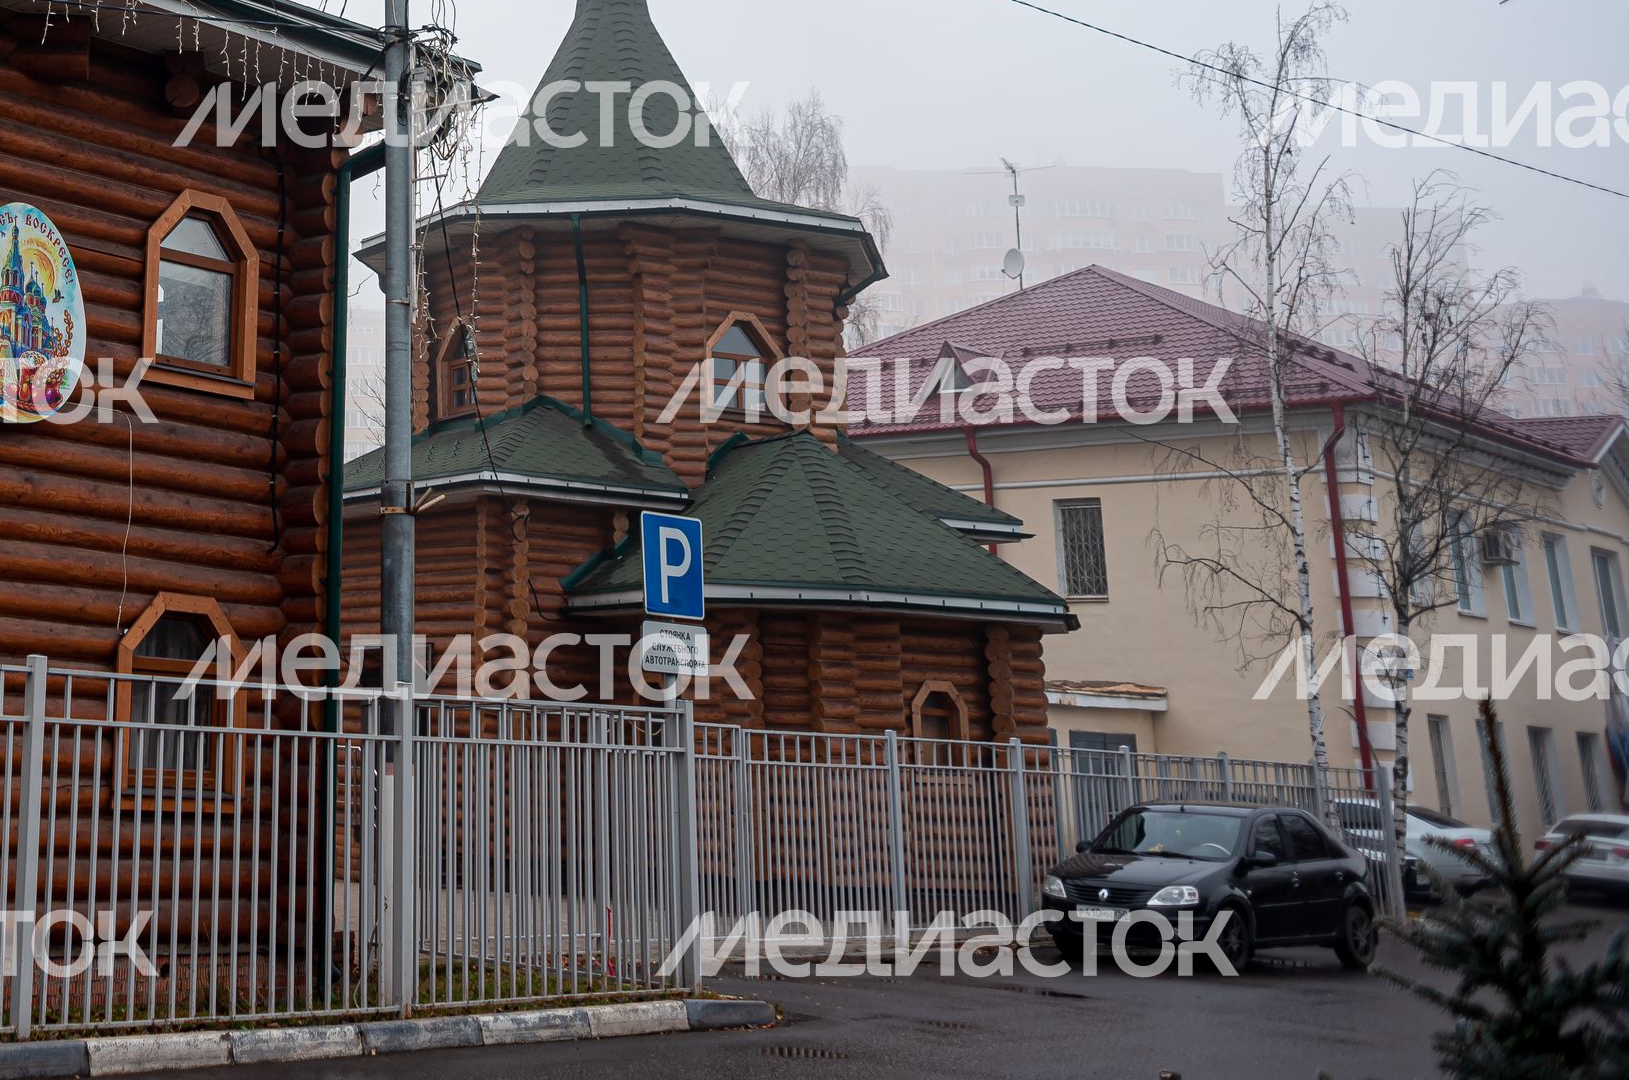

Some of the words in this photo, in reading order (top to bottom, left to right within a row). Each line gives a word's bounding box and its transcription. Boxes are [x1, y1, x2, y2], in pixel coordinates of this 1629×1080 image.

[659, 526, 692, 604] P
[659, 629, 691, 641] СТОЯНКА
[651, 642, 699, 655] СЛУЖЕБНОГО
[644, 655, 707, 669] АВТОТРАНСПОРТА
